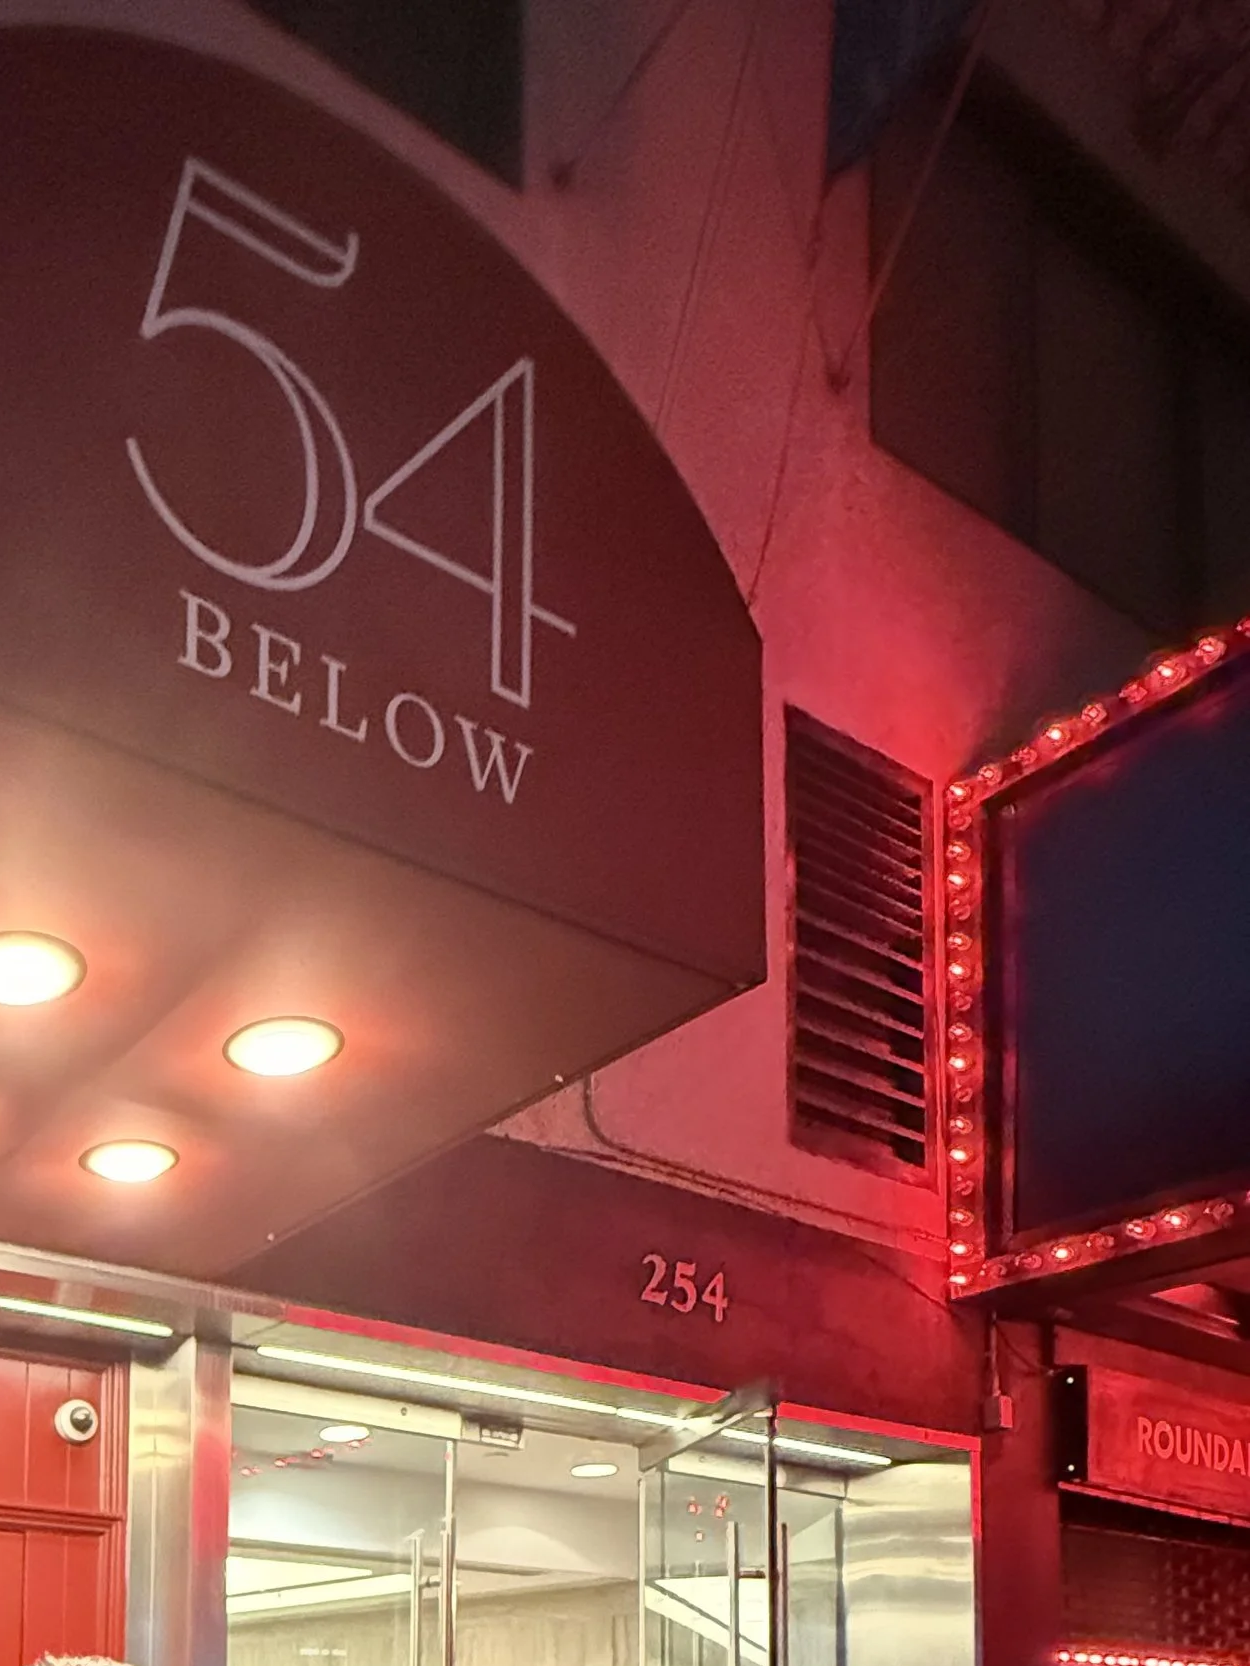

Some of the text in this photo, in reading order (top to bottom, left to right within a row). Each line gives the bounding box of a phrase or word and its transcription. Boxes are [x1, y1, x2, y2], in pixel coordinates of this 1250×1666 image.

[125, 155, 577, 708] 54
[176, 588, 535, 805] BELOW
[641, 1253, 728, 1323] 254
[1137, 1415, 1250, 1478] ROUNDA
